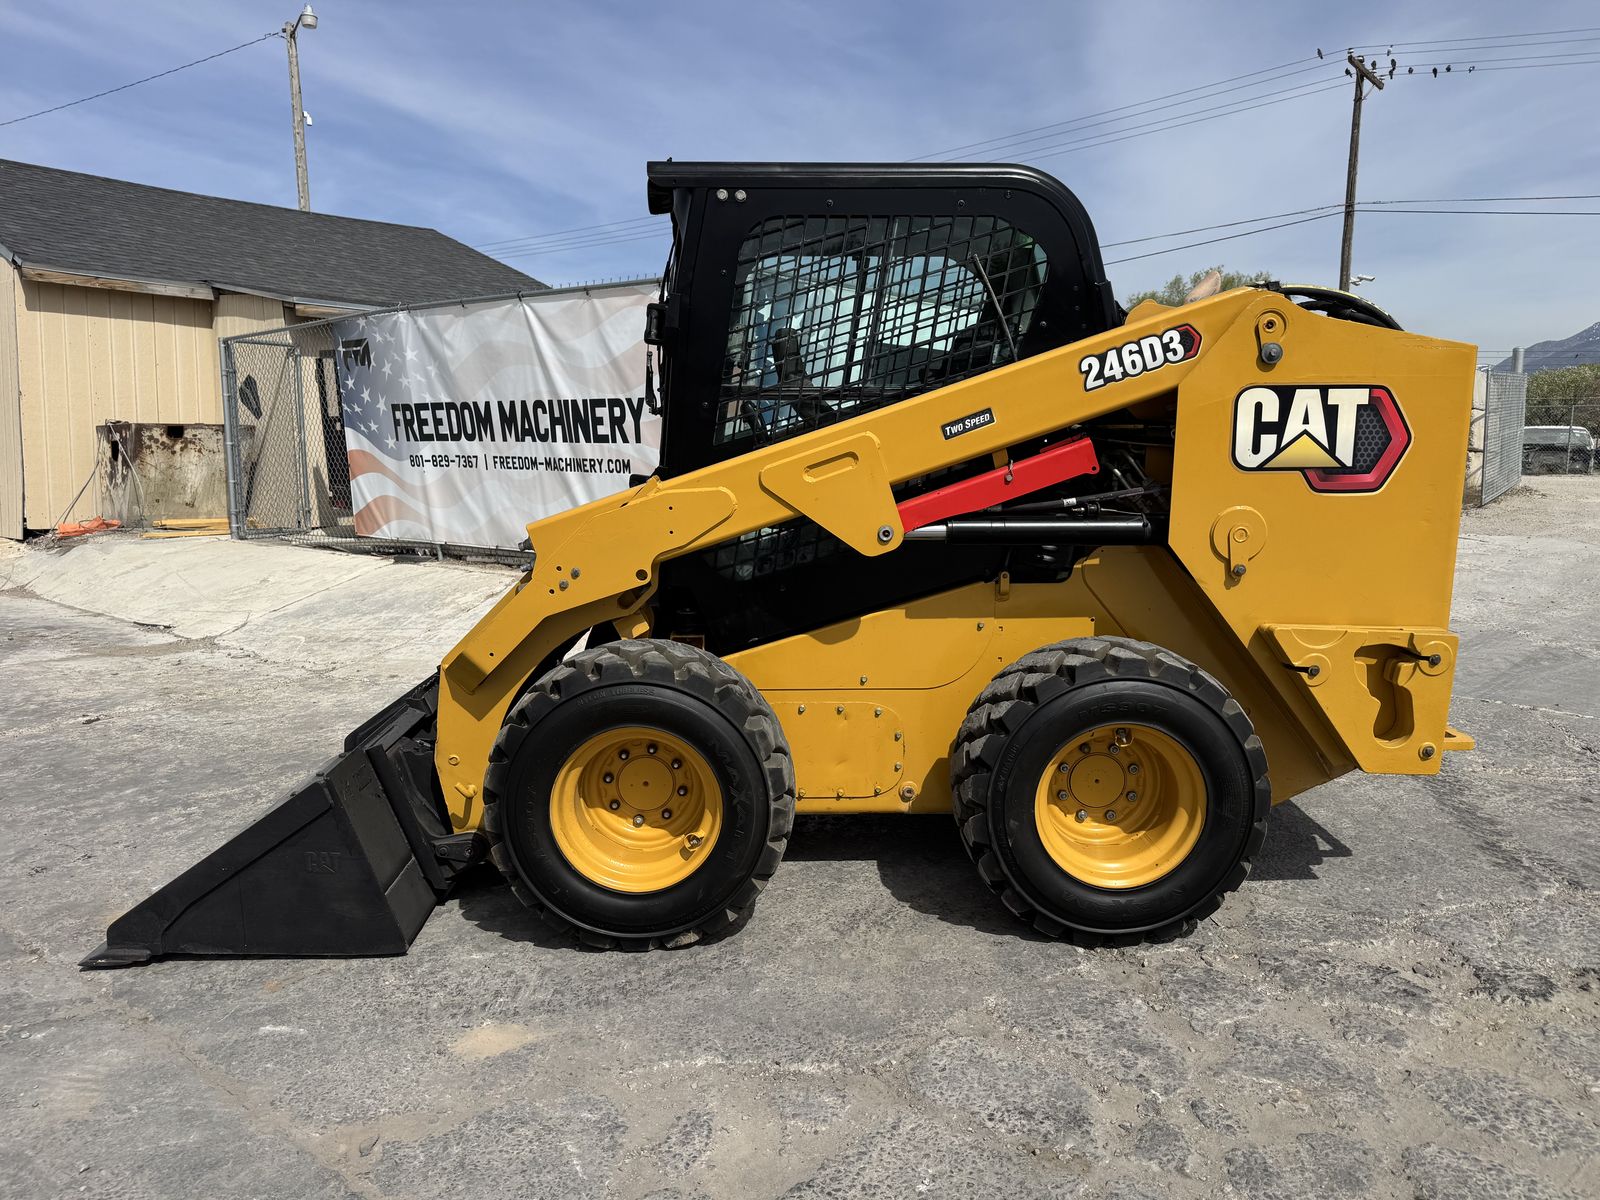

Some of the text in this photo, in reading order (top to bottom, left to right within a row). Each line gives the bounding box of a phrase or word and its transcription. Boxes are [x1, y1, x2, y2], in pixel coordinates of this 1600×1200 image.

[1080, 329, 1185, 390] 246D3
[391, 397, 646, 444] FREEDOM MACHINERY
[1234, 387, 1371, 468] CAT
[409, 455, 479, 469] 801-829-7367
[493, 455, 632, 475] FREEDOM-MACHINERY.COM
